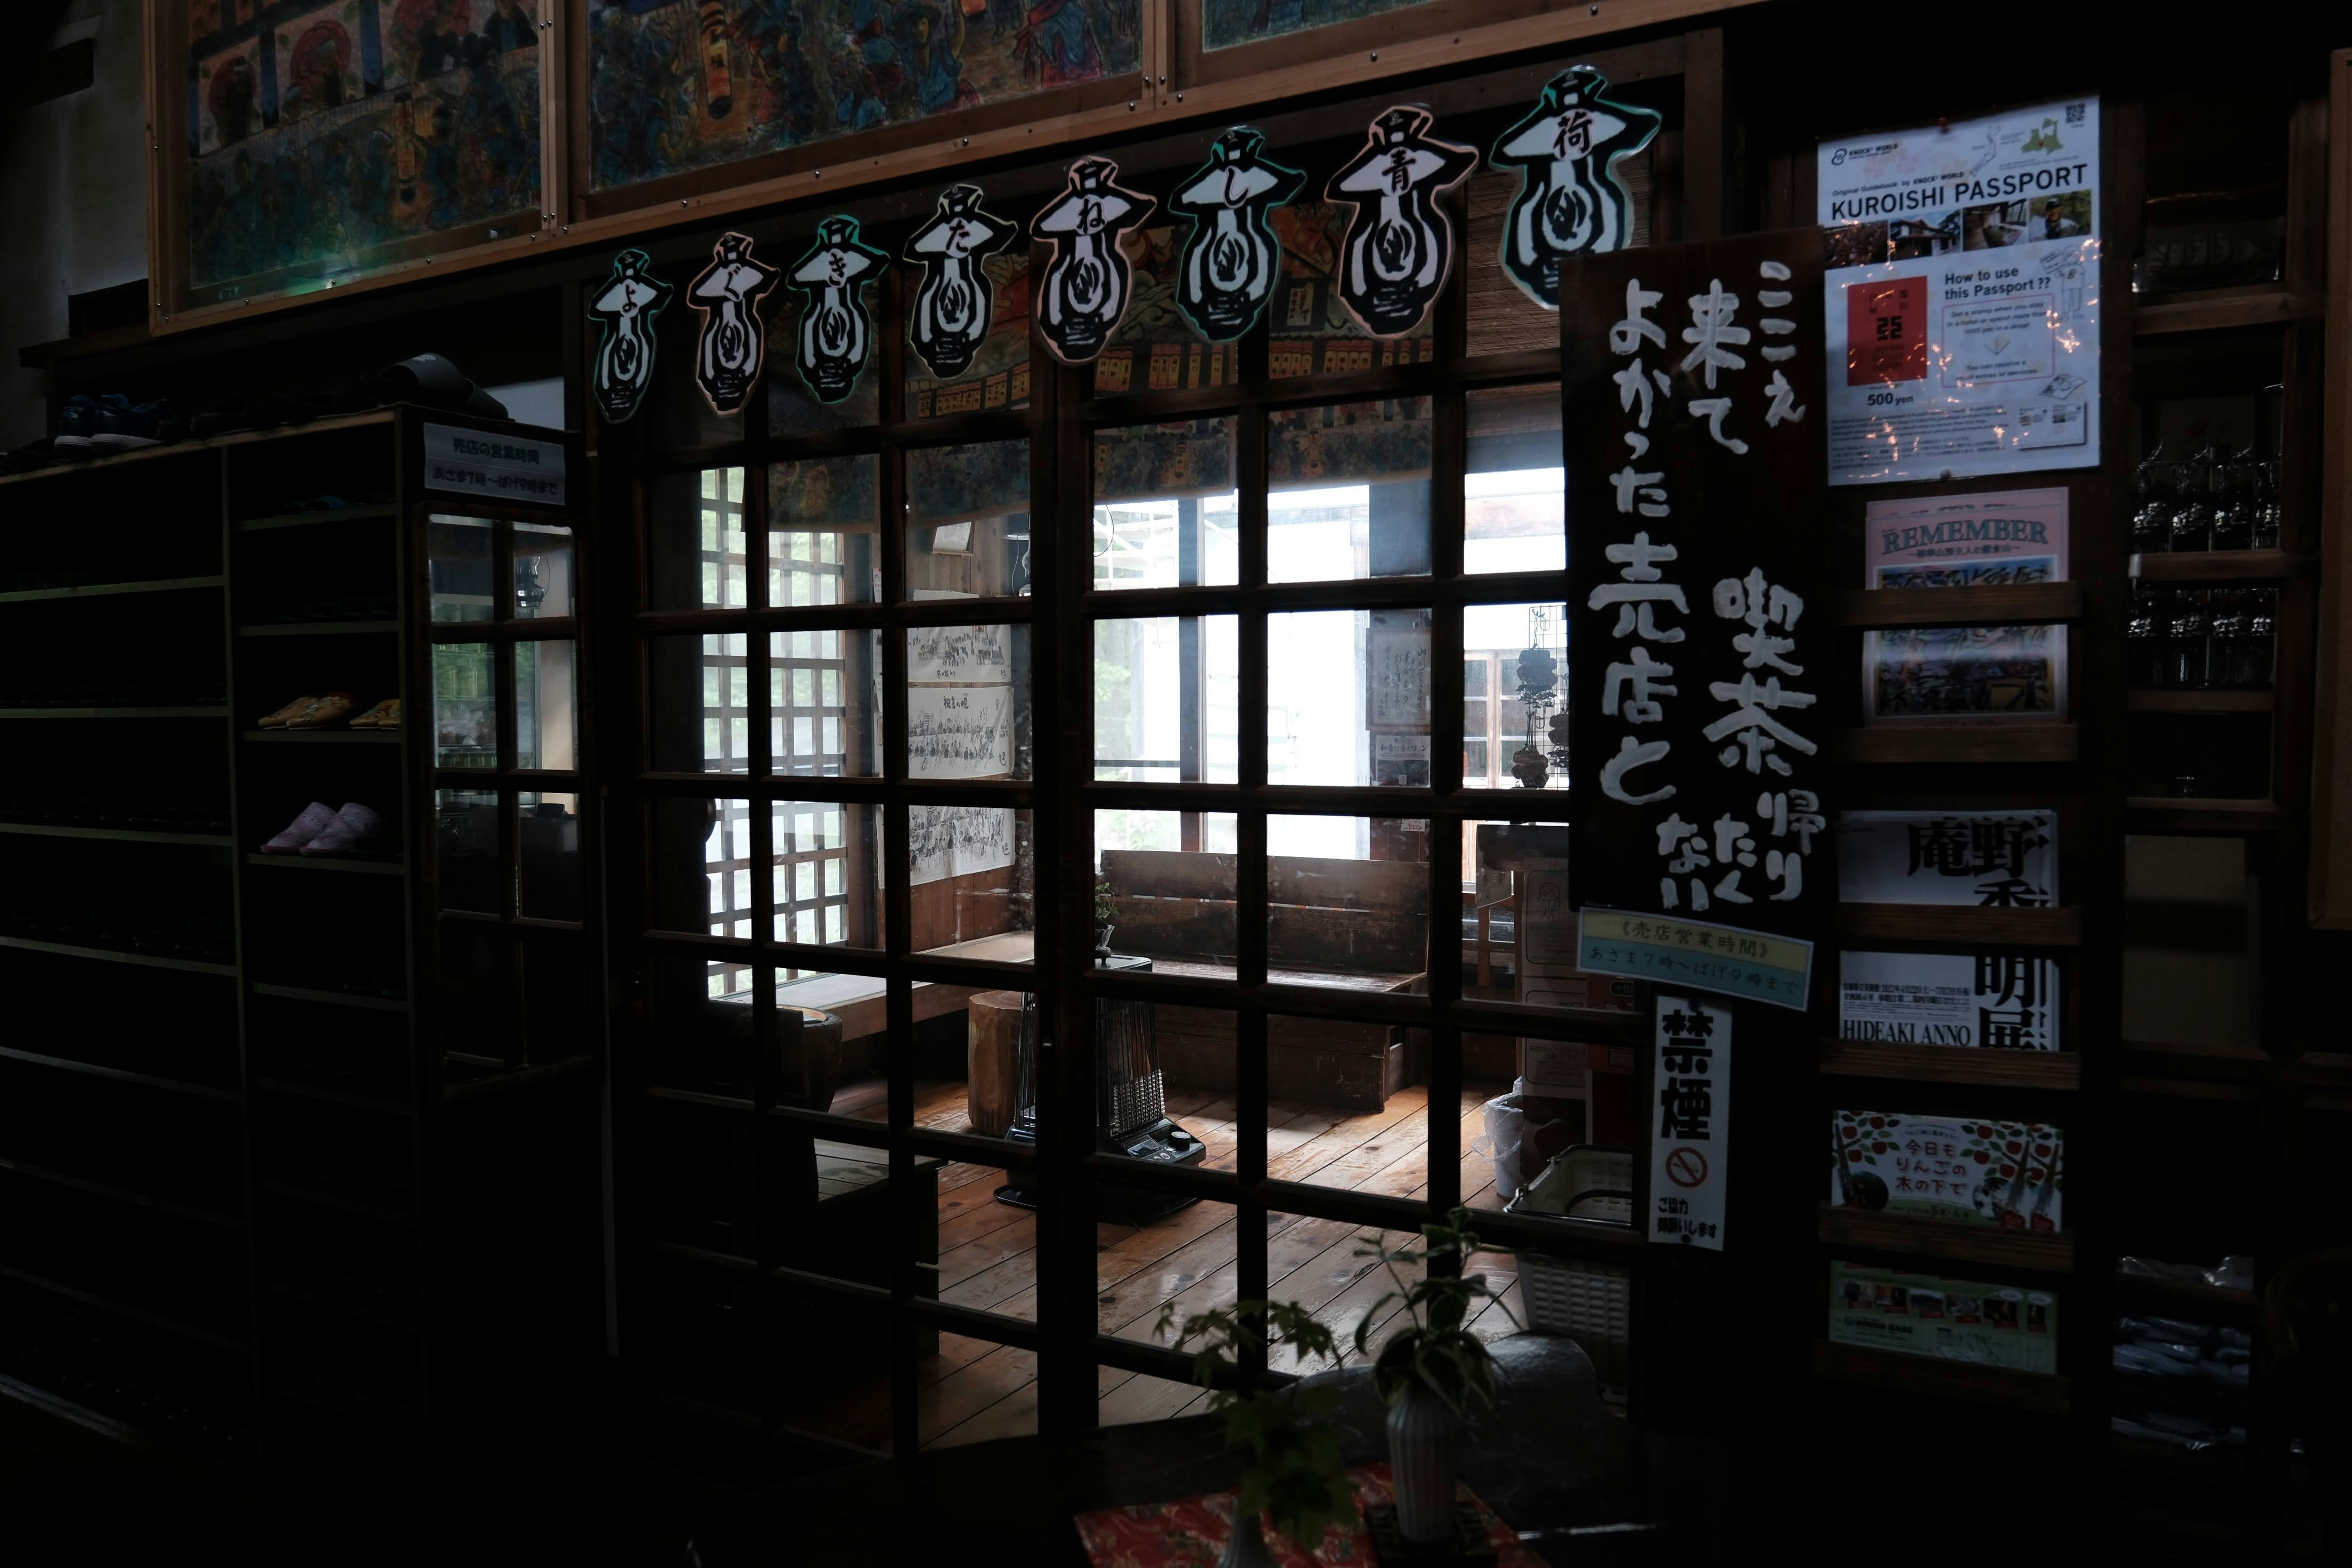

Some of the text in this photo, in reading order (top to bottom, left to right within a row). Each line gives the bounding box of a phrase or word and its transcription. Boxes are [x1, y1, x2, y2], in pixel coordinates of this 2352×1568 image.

[1832, 164, 2088, 220] KUROISHI PASSPORT
[623, 111, 1593, 313] よ ぐ き た ね し 青 荷
[1945, 267, 2019, 285] How to use
[1945, 287, 1969, 300] this
[1974, 280, 2035, 297] Passport
[1680, 277, 1752, 456] 来て
[1868, 393, 1914, 406] 500 yen
[1586, 276, 1690, 806] よかった売店と
[1882, 519, 2049, 556] REMEMBER
[1701, 565, 1818, 778] 喫茶
[1908, 820, 1970, 877] 庵
[1844, 1019, 1971, 1047] HIDEAKI ANNO
[1661, 1009, 1713, 1140] 禁煙
[1905, 1139, 1958, 1157] 今日も
[1896, 1156, 1967, 1177] りんごの
[1896, 1175, 1967, 1197] 木の下で
[1658, 1197, 1688, 1215] ご協力
